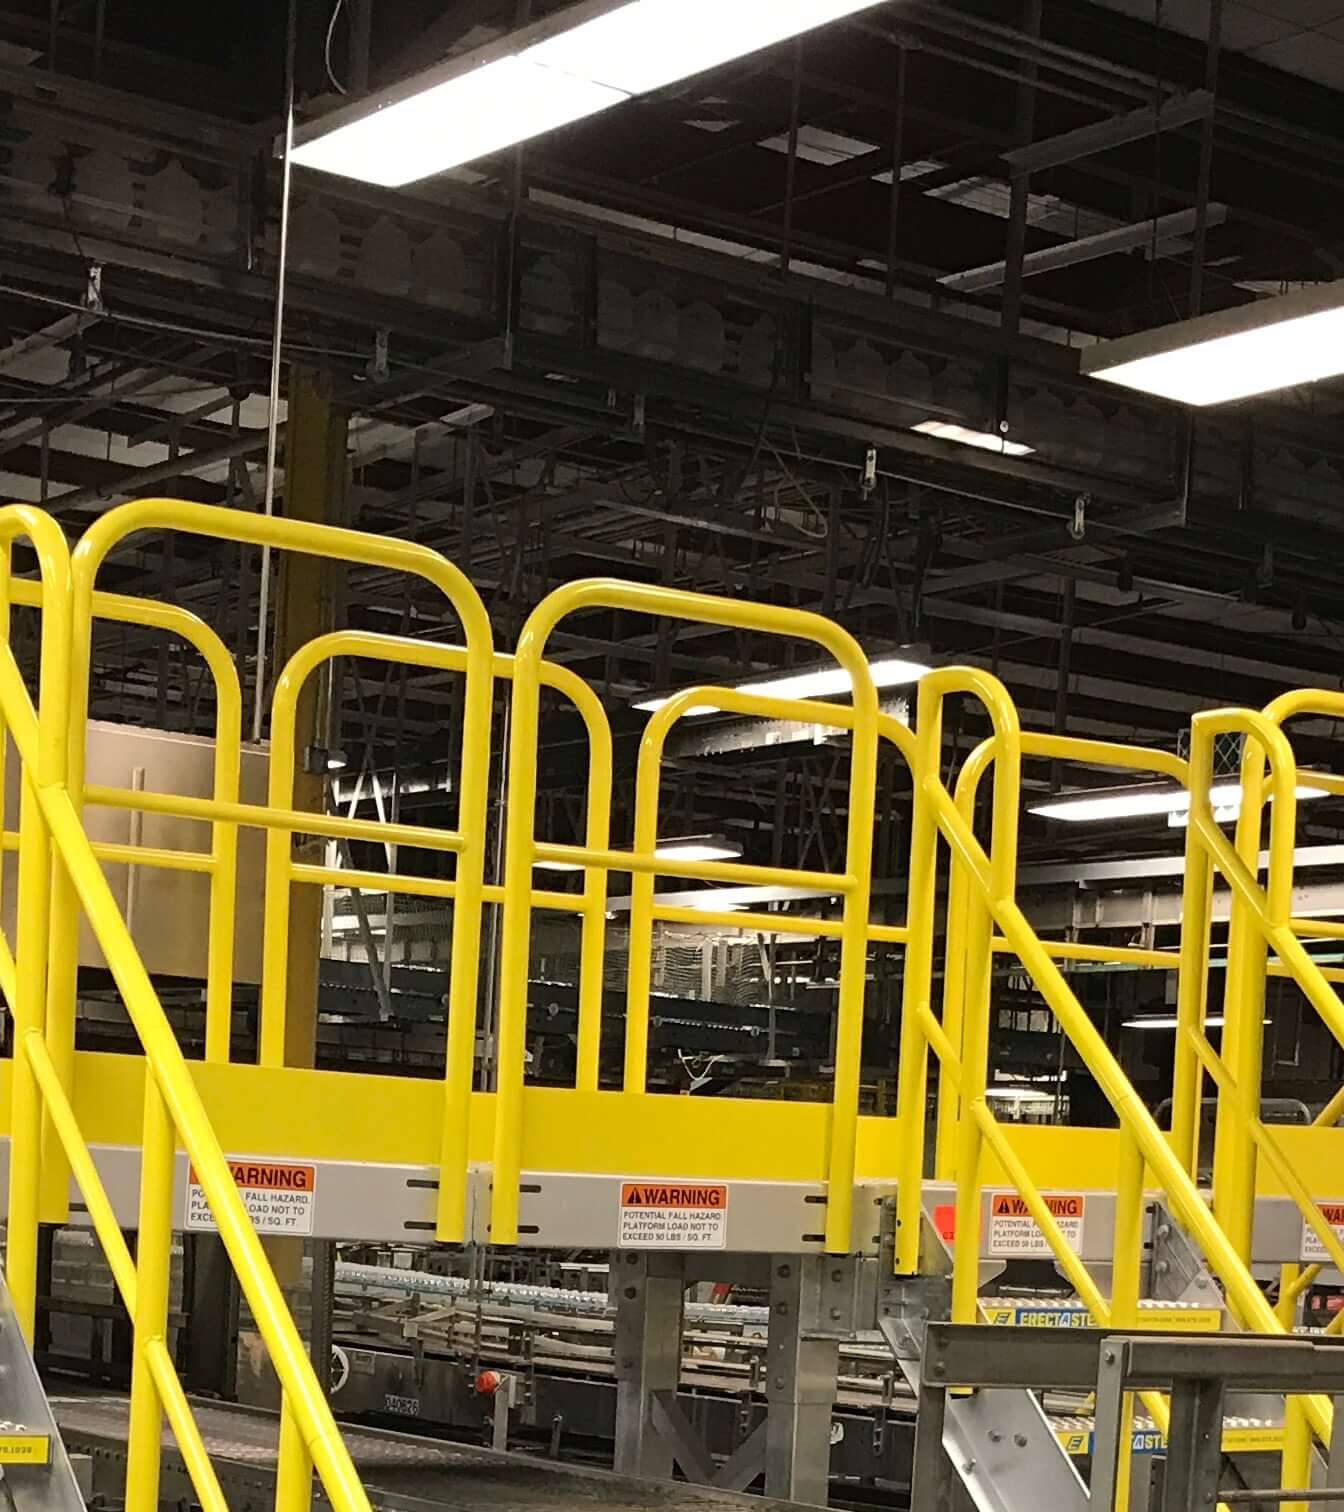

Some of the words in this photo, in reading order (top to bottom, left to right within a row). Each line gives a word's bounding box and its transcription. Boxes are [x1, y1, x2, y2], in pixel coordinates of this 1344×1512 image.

[245, 1191, 268, 1202] FALL
[643, 1188, 720, 1206] WARNING
[271, 1205, 291, 1215] NOT
[293, 1206, 305, 1216] TO
[191, 1213, 215, 1222] EXCE
[623, 1211, 666, 1220] POTENTIAL
[668, 1211, 687, 1220] FALL
[623, 1221, 665, 1230] PLATFORM
[667, 1222, 688, 1231] LOAD
[690, 1223, 707, 1231] NOT
[708, 1223, 719, 1231] TO
[994, 1220, 1031, 1228] POTENTIAL
[622, 1232, 654, 1241] EXCEED
[993, 1230, 1030, 1238] PLATFORM
[993, 1239, 1020, 1248] EXCEED
